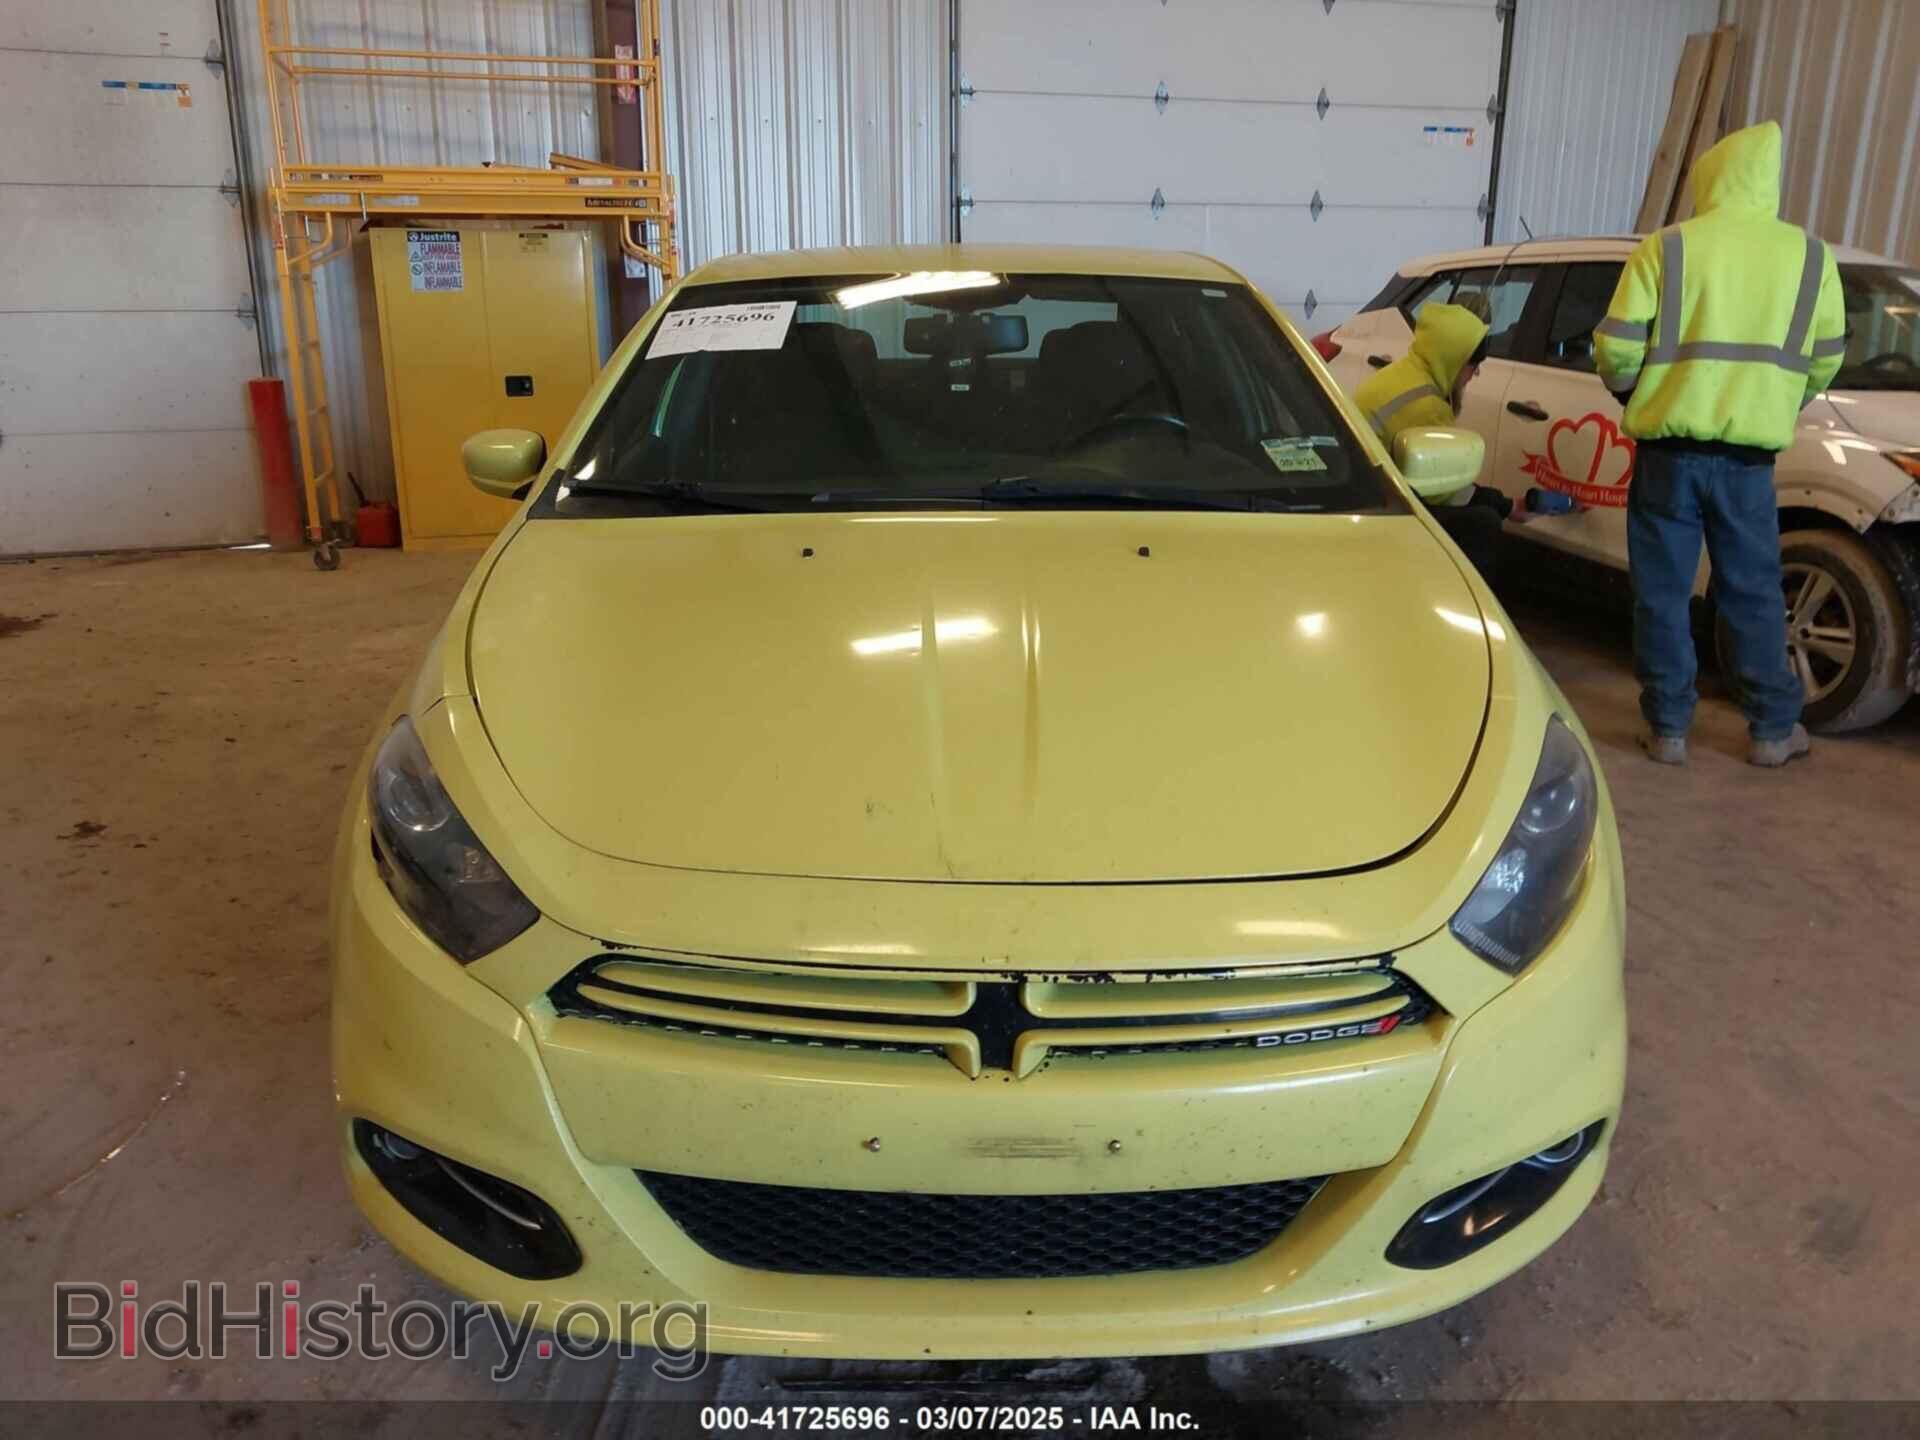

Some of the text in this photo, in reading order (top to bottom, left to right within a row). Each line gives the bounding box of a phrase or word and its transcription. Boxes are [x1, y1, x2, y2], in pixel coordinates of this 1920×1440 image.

[420, 232, 457, 241] Justrite
[420, 243, 460, 255] FLAMMABLE
[671, 312, 775, 328] 41725696
[1256, 1023, 1383, 1047] DODGE
